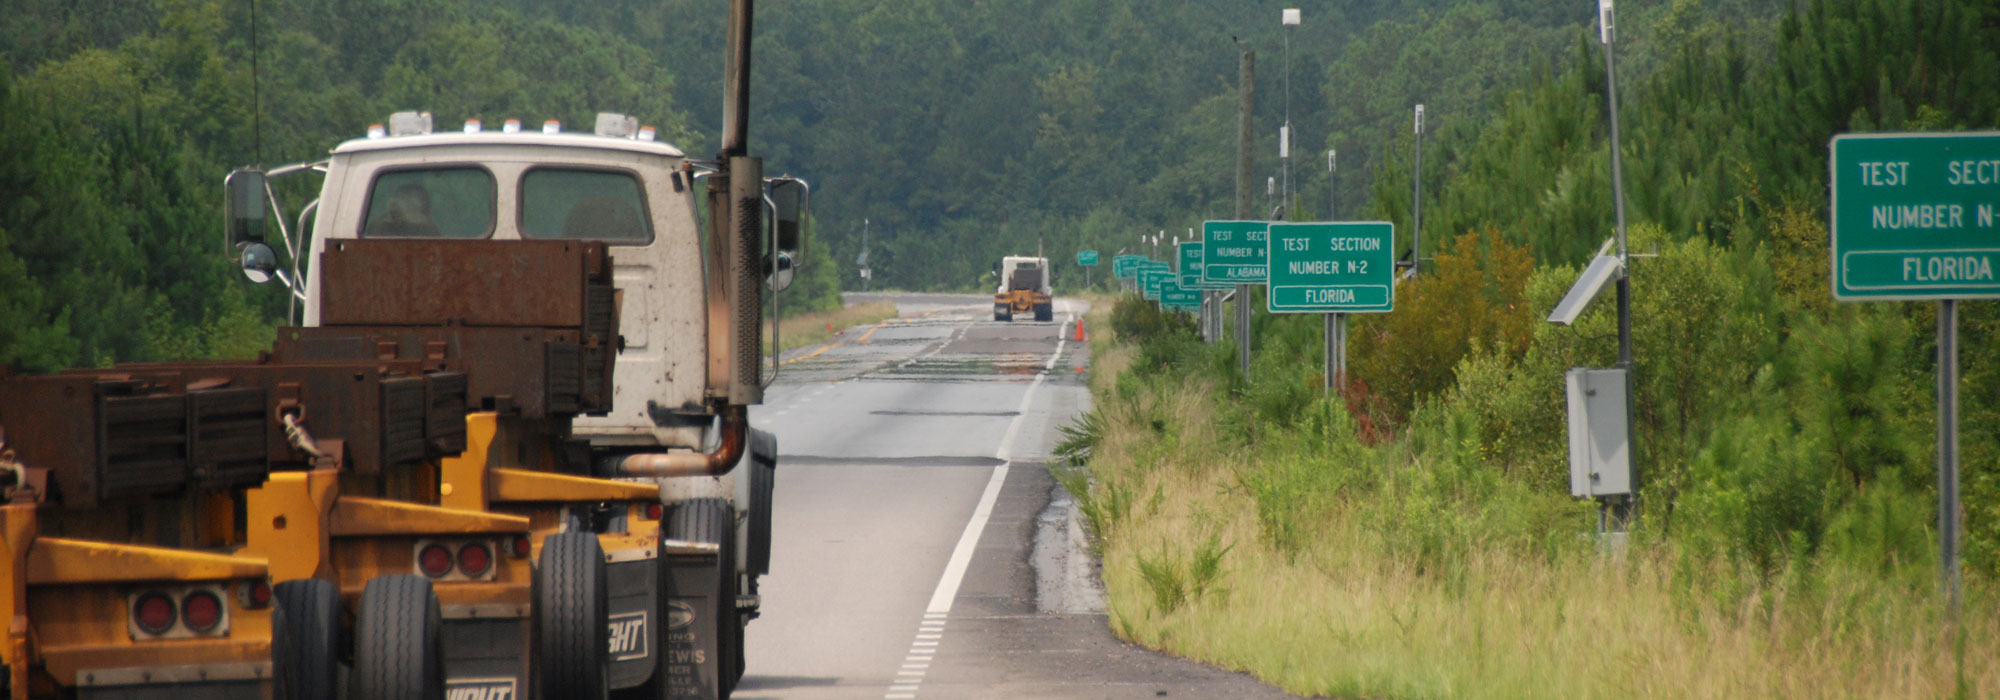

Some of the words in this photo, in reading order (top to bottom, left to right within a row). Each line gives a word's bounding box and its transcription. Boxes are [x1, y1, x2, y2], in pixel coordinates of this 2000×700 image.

[1859, 161, 1910, 186] TEST
[1947, 160, 2000, 185] SECT
[1872, 204, 1963, 229] NUMBER
[1212, 230, 1232, 241] TEST
[1282, 238, 1310, 251] TEST
[1330, 237, 1381, 251] SECTION
[1217, 247, 1252, 257] NUMBER
[1226, 267, 1266, 278] ALABAMA
[1289, 261, 1339, 275] NUMBER
[1347, 260, 1368, 275] N-2
[1903, 256, 1993, 281] FLORIDA
[1305, 289, 1355, 303] FLORIDA
